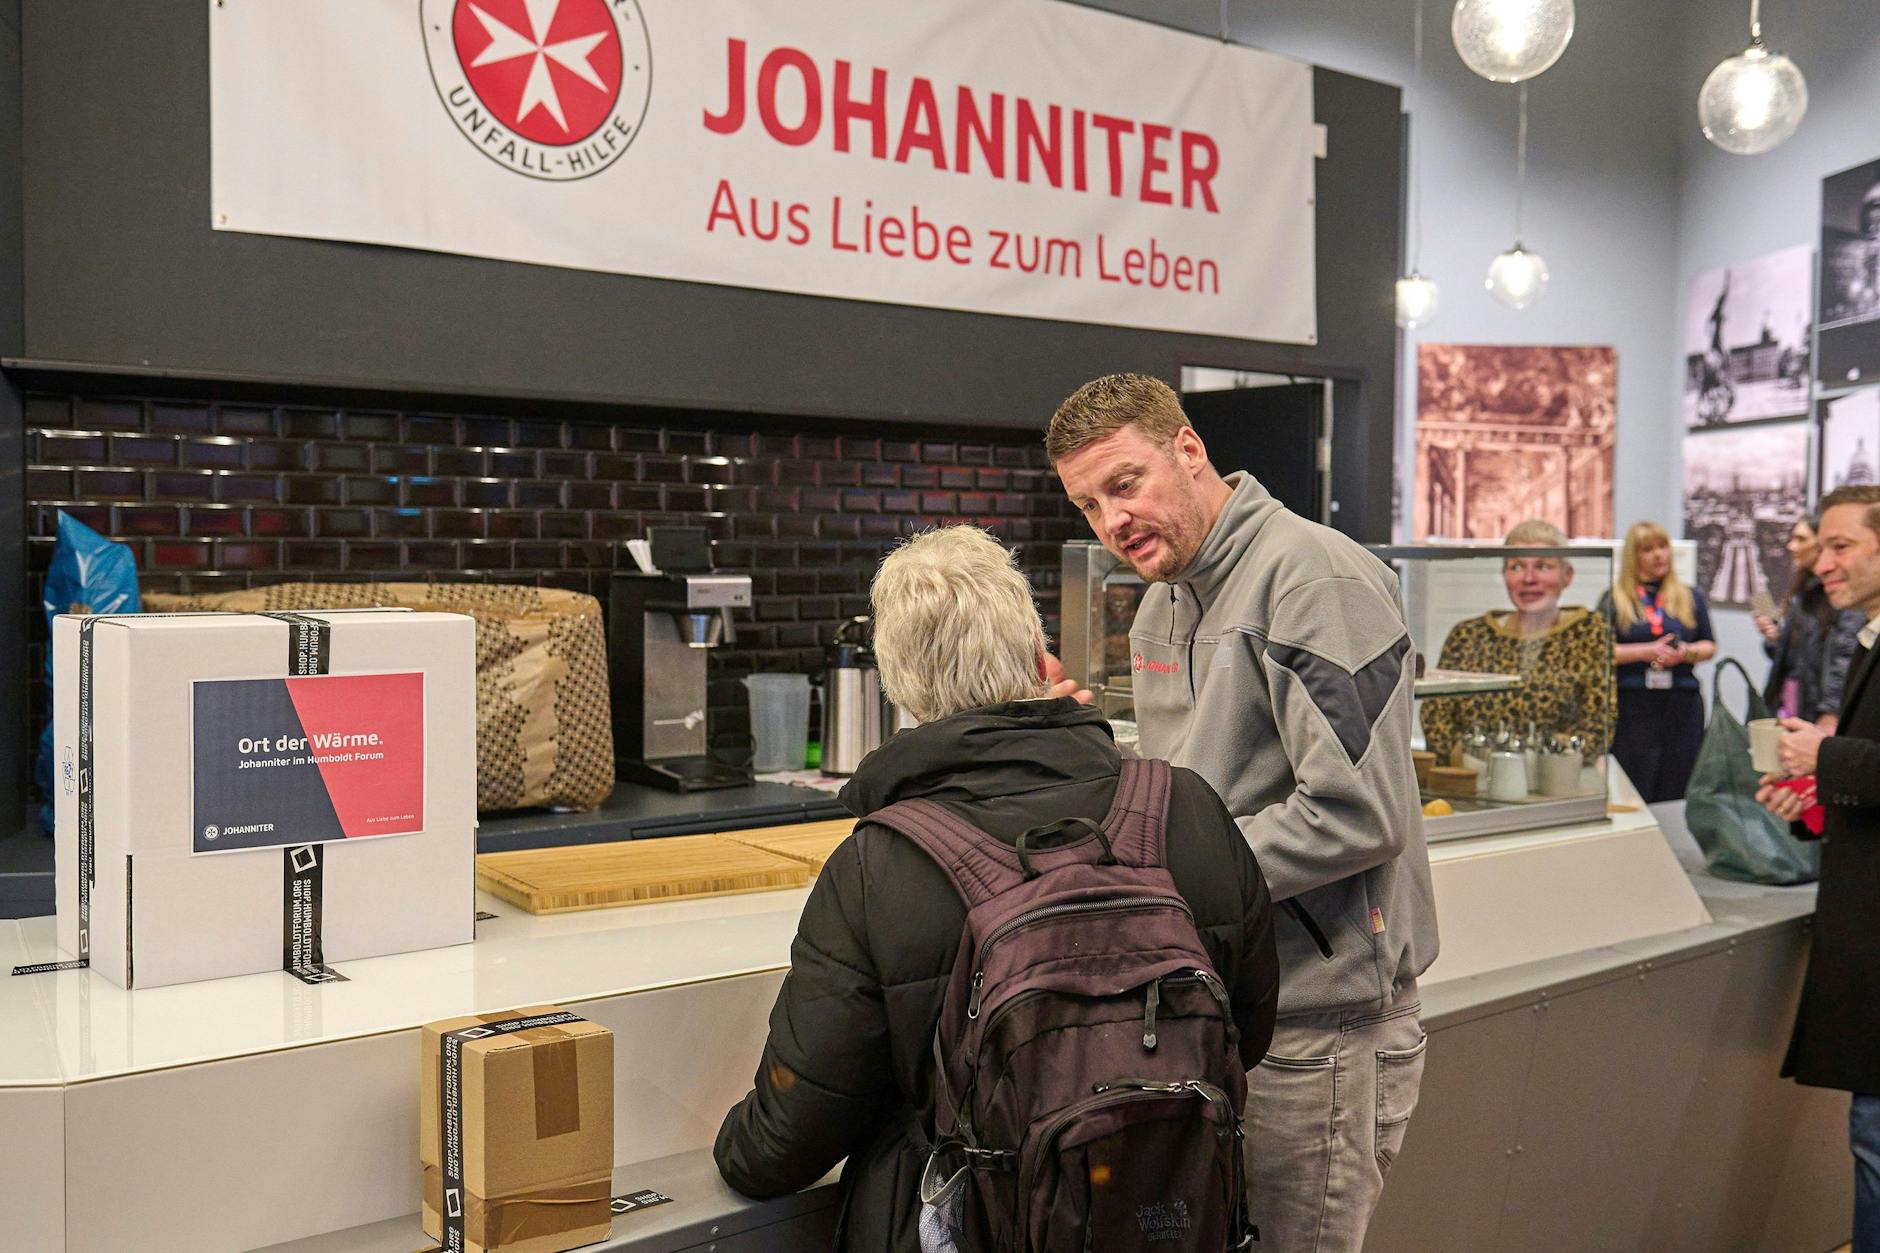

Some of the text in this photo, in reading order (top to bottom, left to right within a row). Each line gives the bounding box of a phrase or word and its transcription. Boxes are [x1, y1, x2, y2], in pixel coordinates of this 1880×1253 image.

[450, 86, 631, 173] UNFALL-HILFE
[703, 38, 1220, 213] JOHANNITER
[706, 179, 1220, 295] Aus Liebe zum Leben
[238, 732, 384, 753] Ort der Wärme.
[238, 752, 384, 769] Johanniter im Humboldt Forum
[223, 823, 274, 835] JOHANNITER
